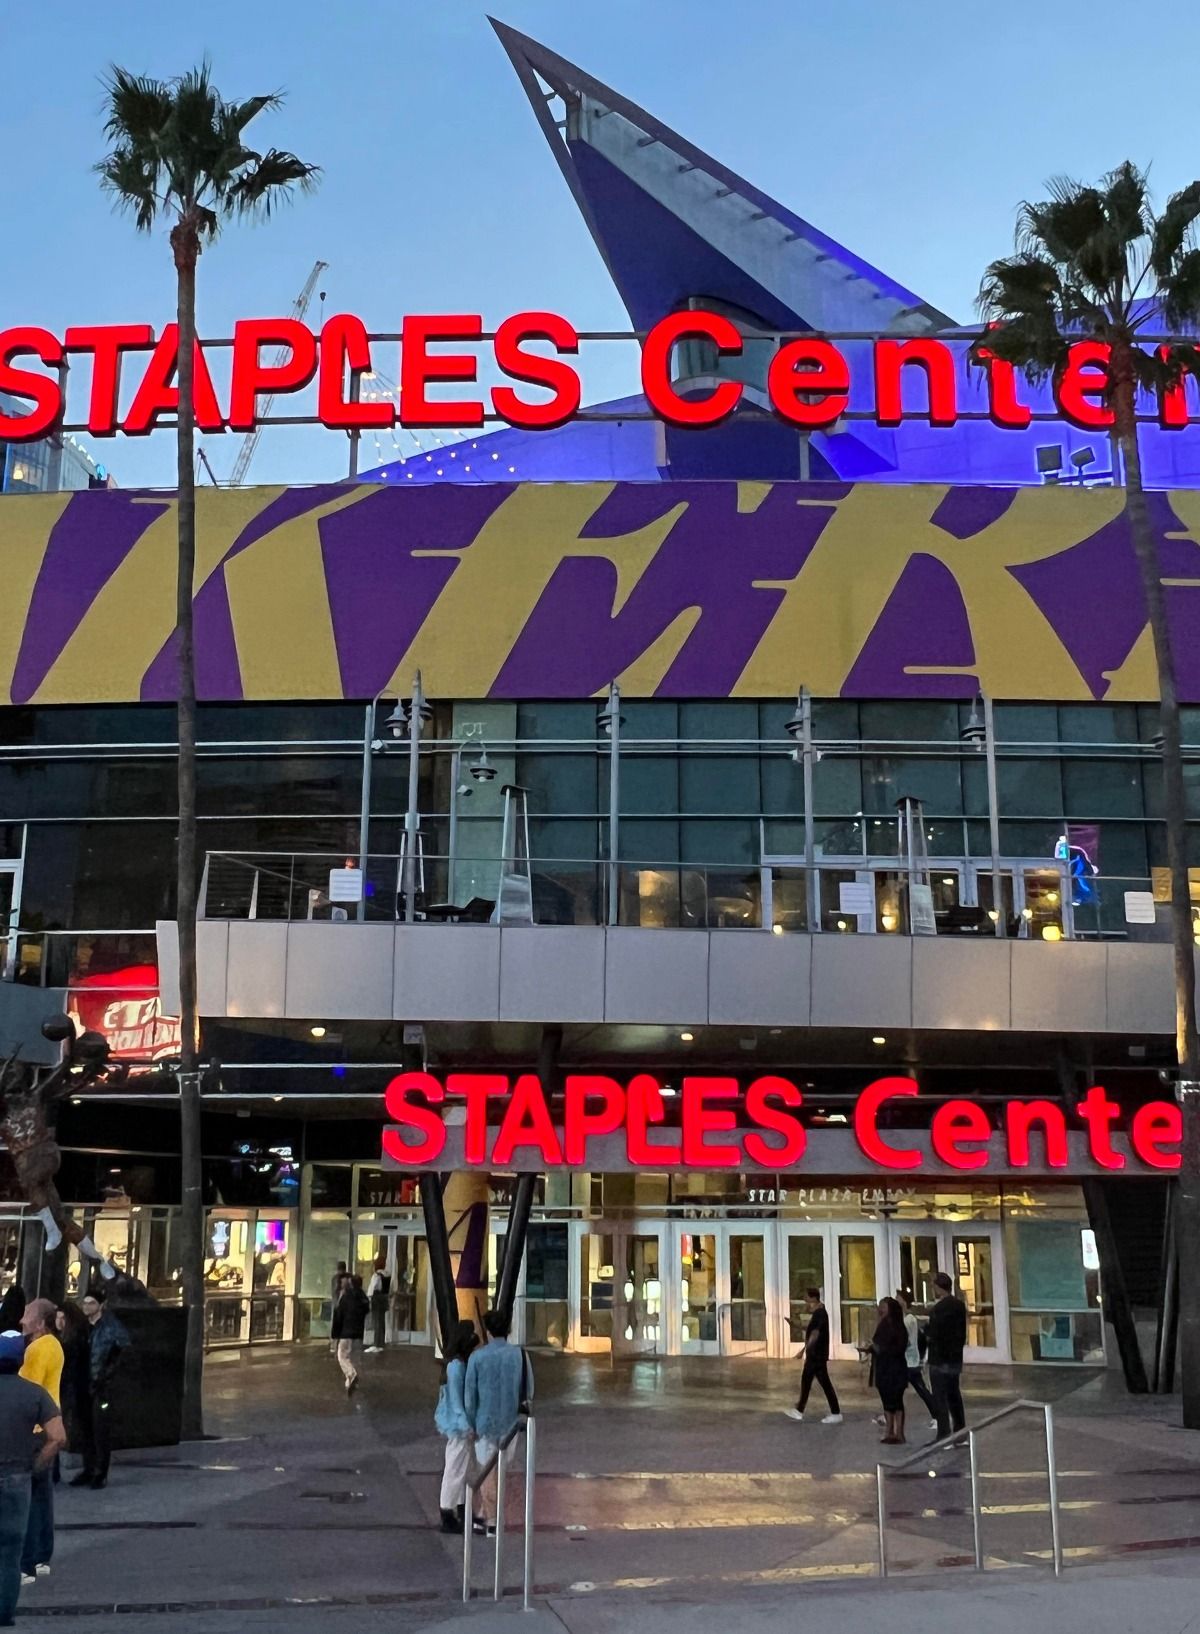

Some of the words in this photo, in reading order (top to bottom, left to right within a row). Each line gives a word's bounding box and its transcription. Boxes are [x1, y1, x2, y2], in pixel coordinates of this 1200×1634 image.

[0, 312, 582, 441] STAPLES
[382, 1071, 808, 1166] STAPLES
[854, 1077, 1183, 1170] Cente
[748, 1188, 787, 1202] STAR
